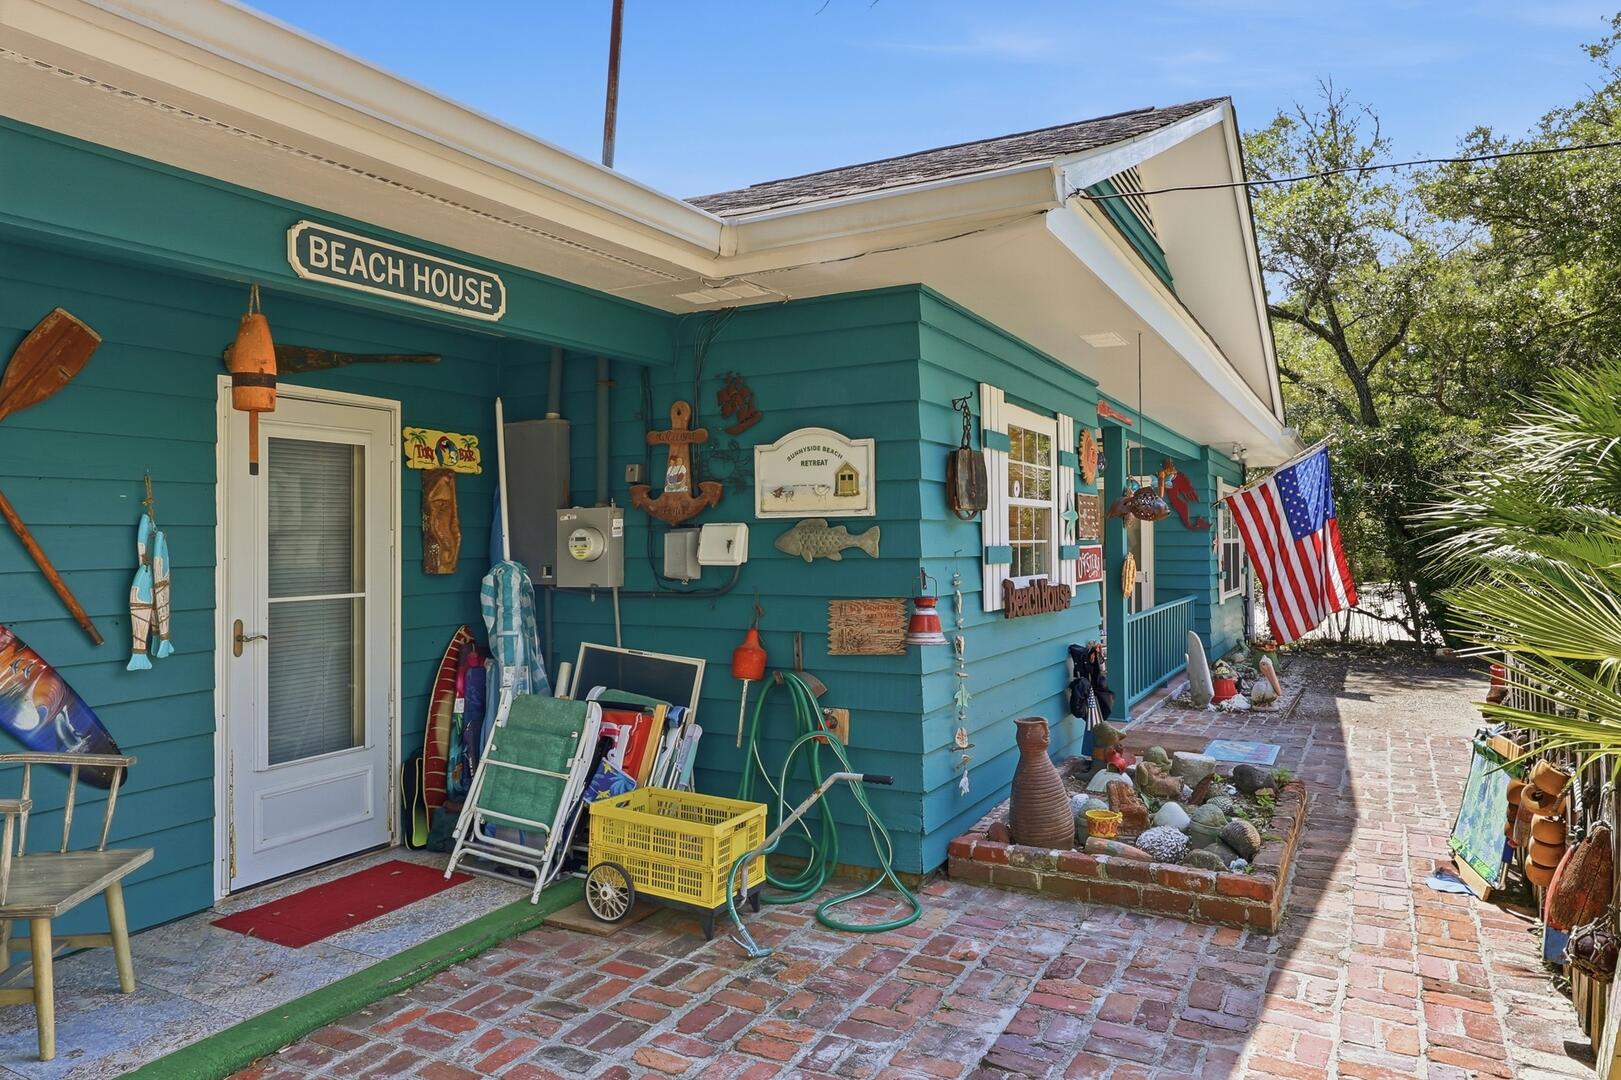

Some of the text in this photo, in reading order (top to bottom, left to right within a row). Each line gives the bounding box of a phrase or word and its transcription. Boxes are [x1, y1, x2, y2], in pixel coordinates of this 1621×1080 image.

[309, 235, 493, 309] BEACH HOUSE
[786, 445, 843, 462] SUNNYSIDE BEACH
